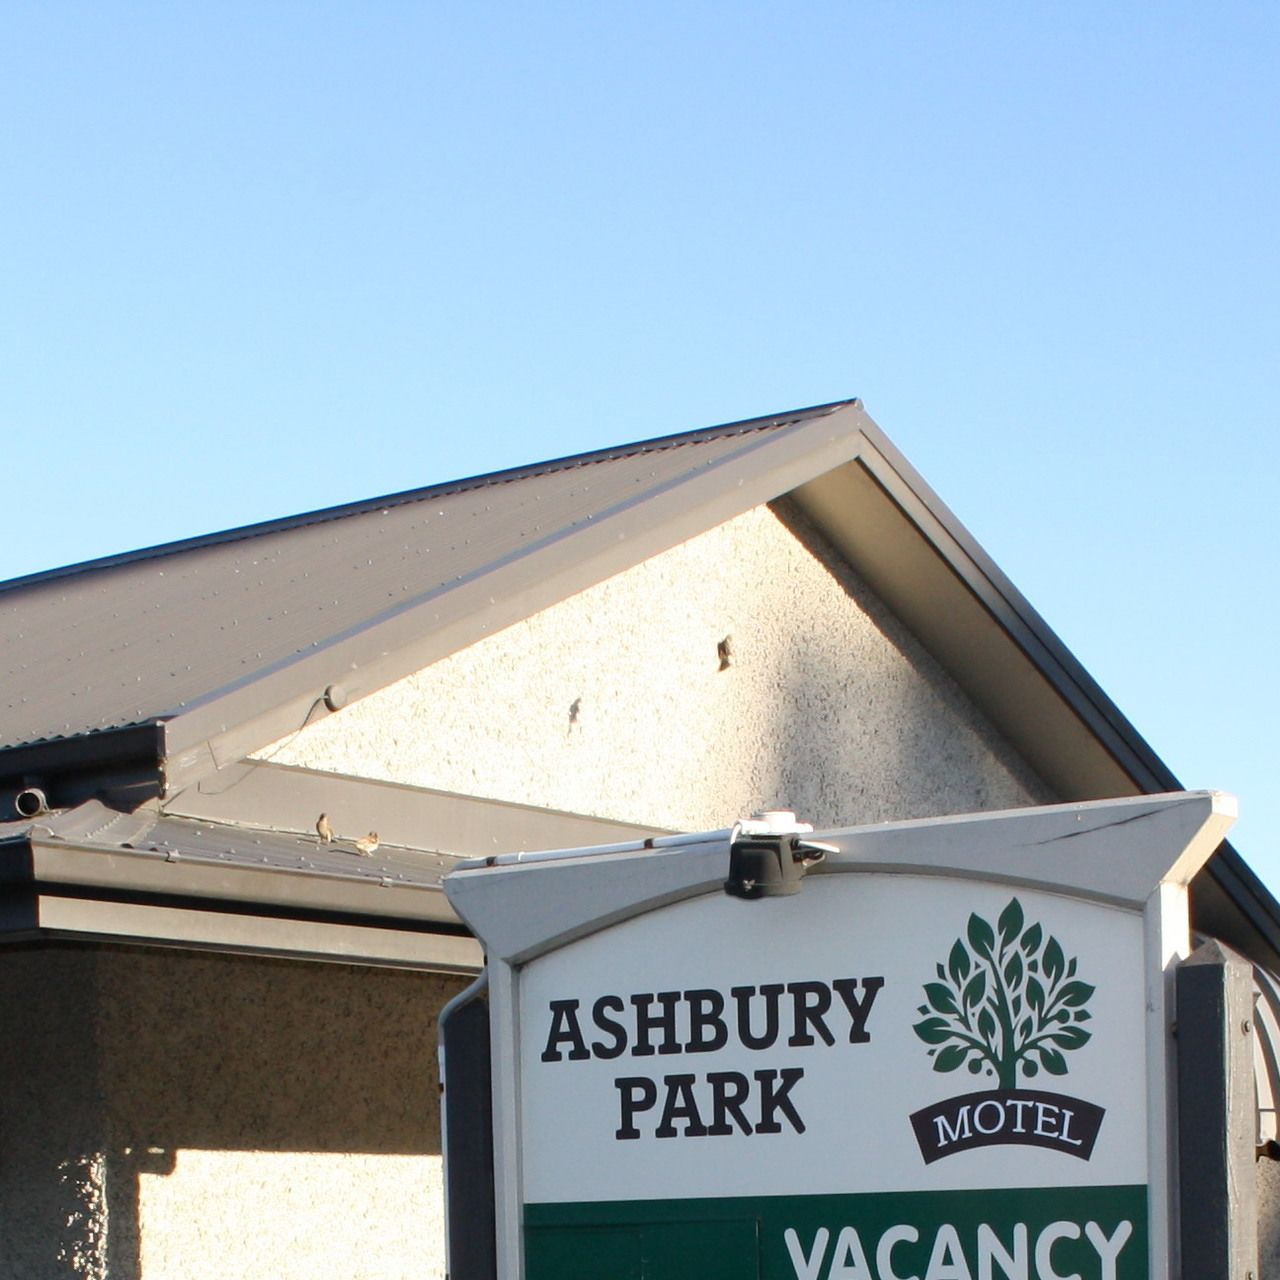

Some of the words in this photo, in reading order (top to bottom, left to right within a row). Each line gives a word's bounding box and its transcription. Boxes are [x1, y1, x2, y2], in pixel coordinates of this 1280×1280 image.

[541, 976, 885, 1063] ASHBURY
[615, 1067, 807, 1141] PARK
[933, 1099, 1083, 1149] MOTEL
